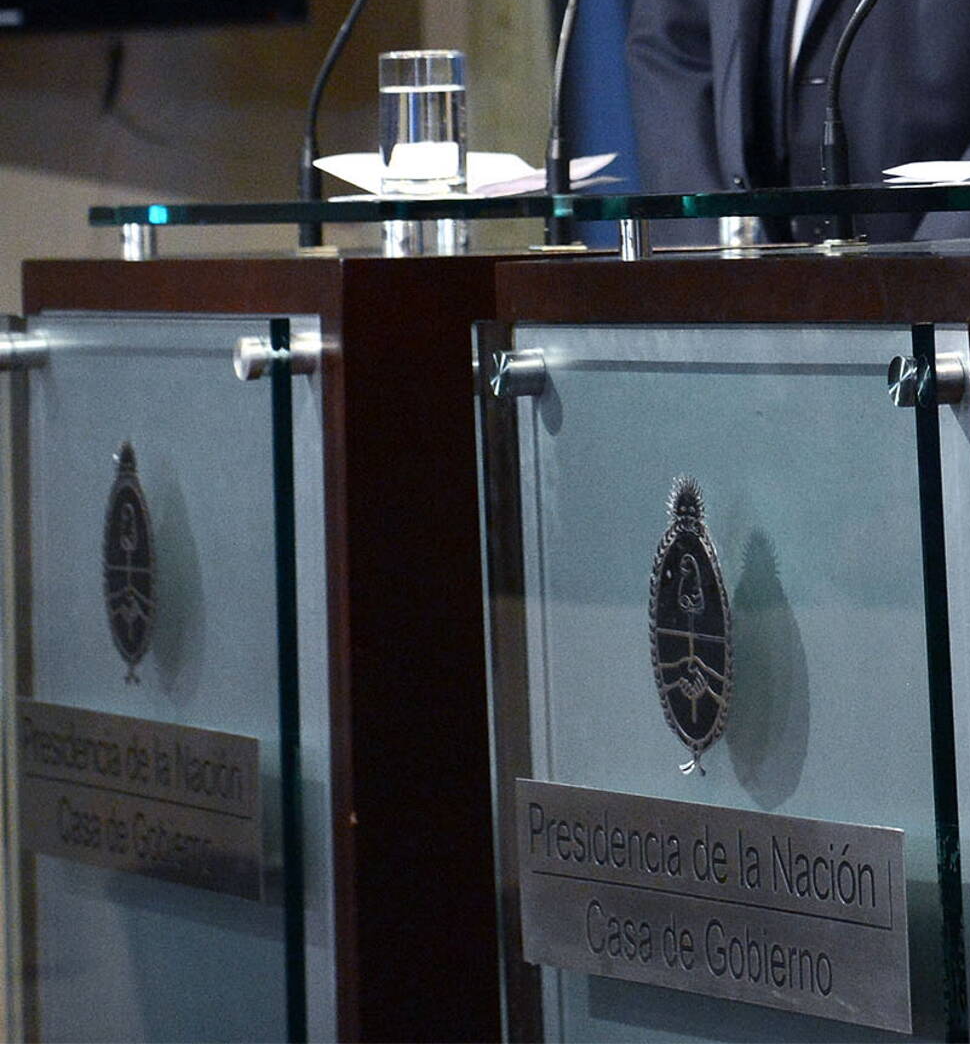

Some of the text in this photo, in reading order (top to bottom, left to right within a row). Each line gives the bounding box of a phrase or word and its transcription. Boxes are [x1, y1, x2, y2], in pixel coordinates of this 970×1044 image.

[529, 802, 876, 907] Presidencia de la Nación
[586, 899, 833, 997] Casa de Gobierno
